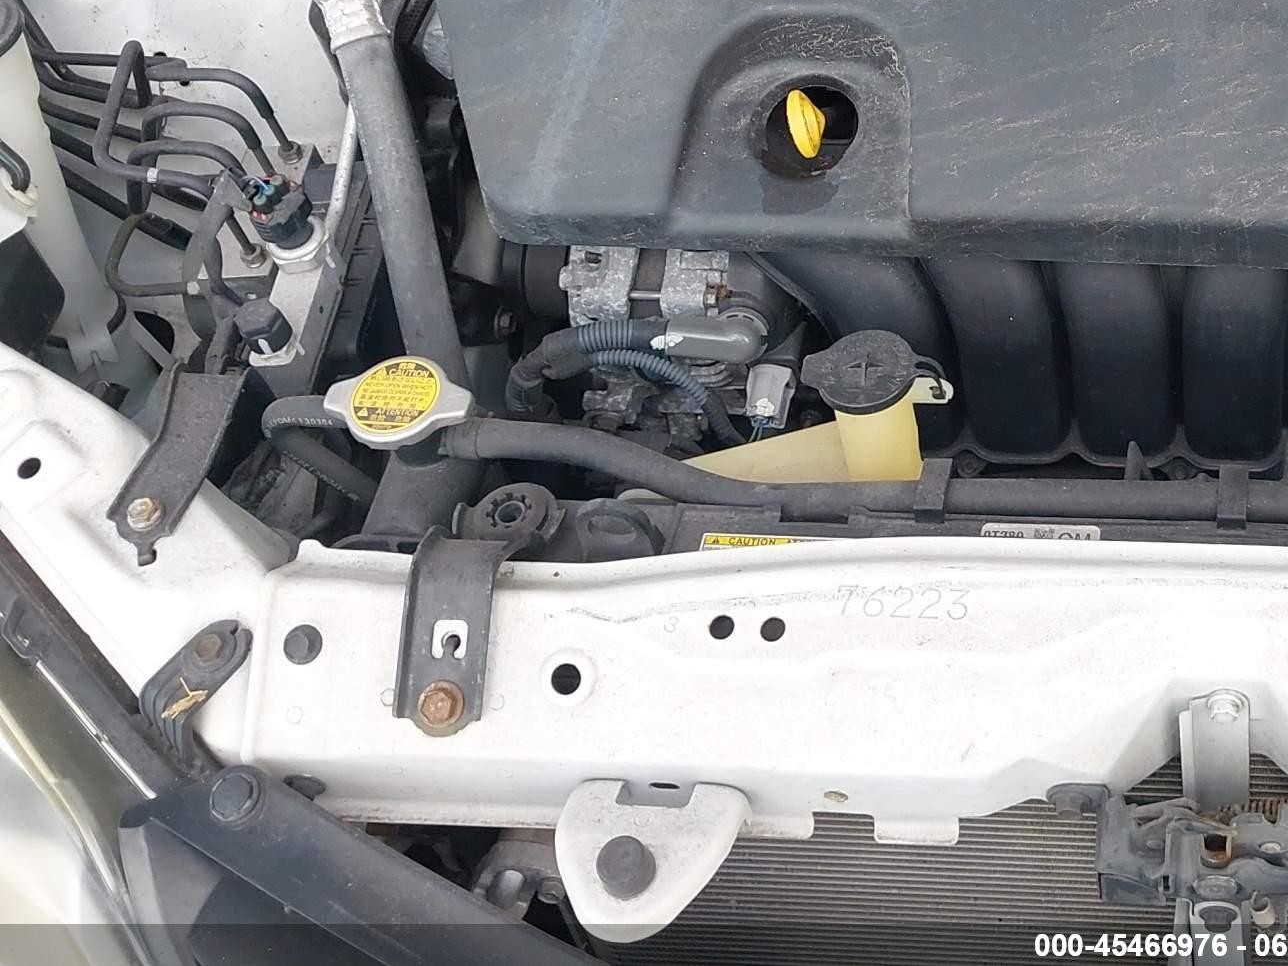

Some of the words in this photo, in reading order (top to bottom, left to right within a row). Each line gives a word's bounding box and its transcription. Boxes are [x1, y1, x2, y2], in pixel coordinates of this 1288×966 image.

[389, 368, 430, 378] CAUTION
[376, 408, 419, 417] ATTENTION
[728, 537, 777, 546] CAUTION
[838, 585, 970, 621] 76223
